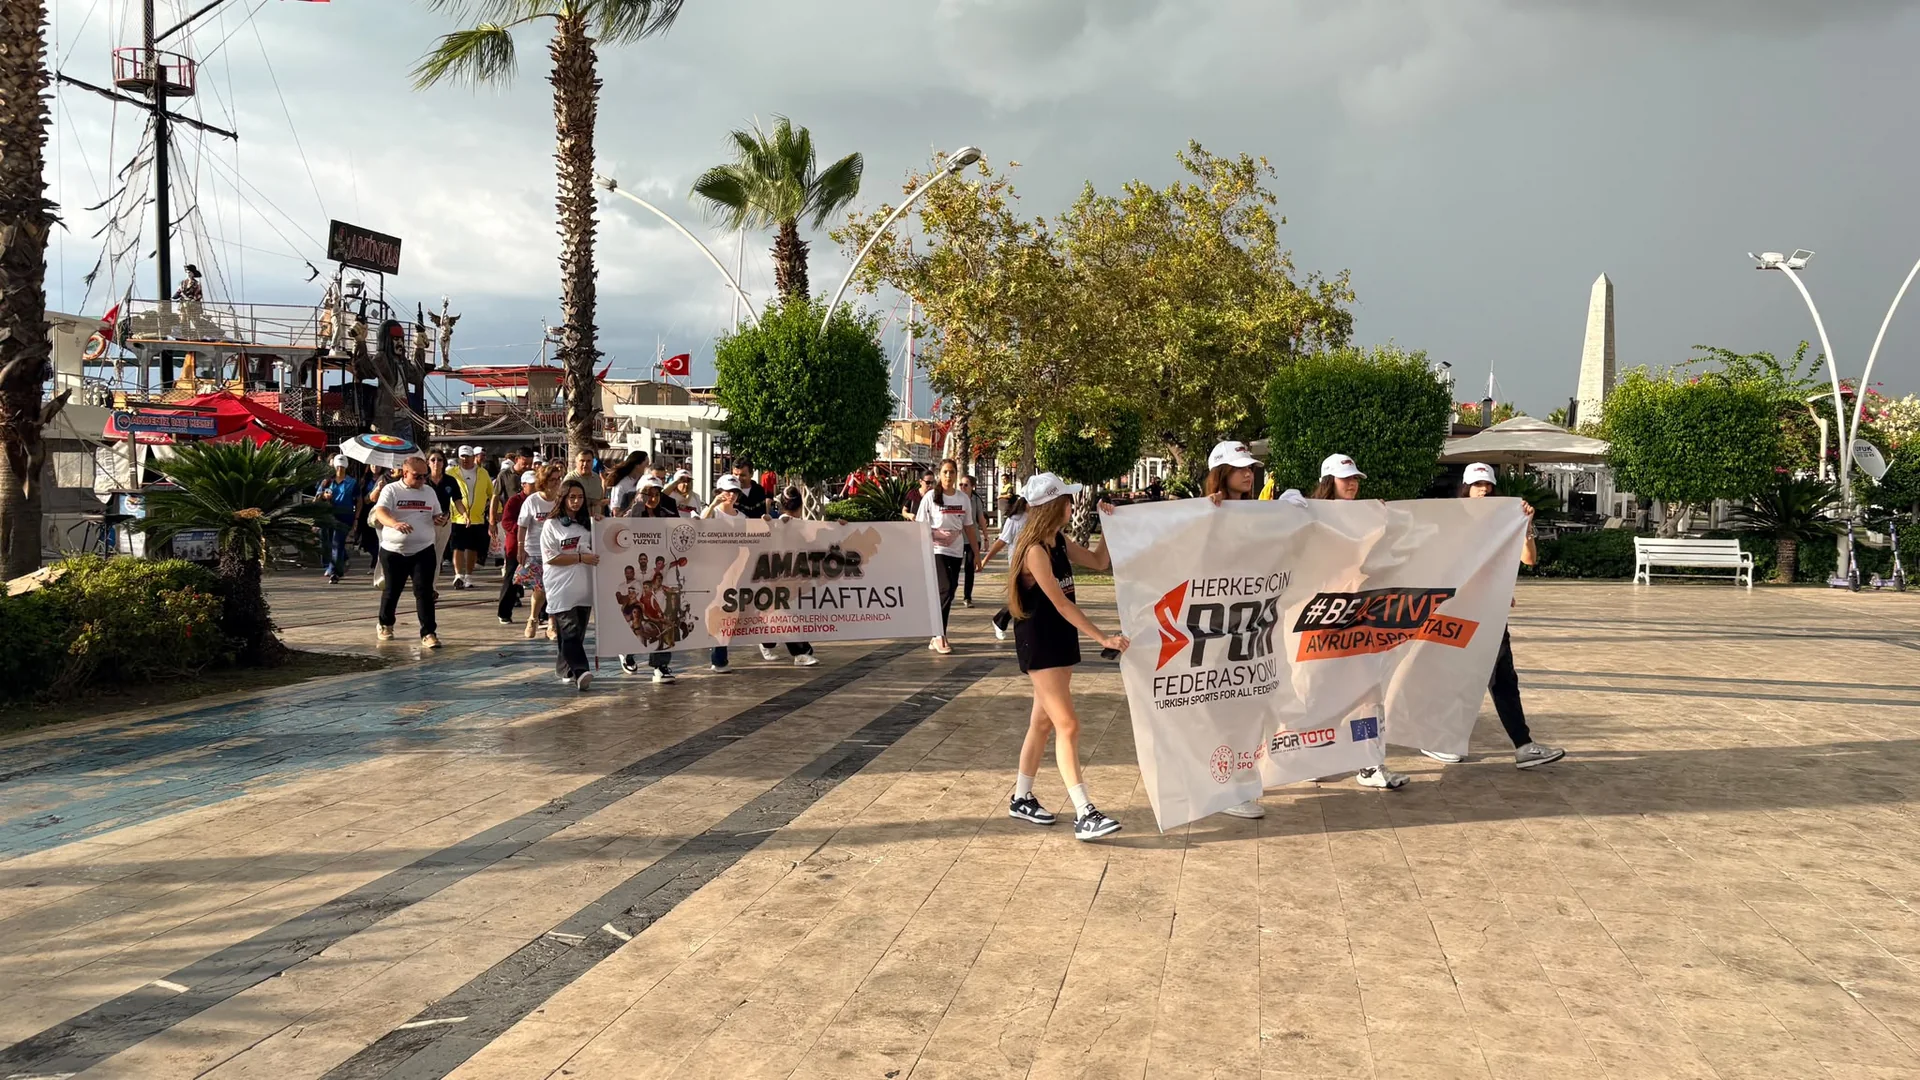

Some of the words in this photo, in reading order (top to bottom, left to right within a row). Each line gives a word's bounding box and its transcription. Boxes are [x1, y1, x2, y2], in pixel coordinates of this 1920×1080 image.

[752, 545, 863, 581] AMATÖR
[1191, 577, 1265, 598] HERKES
[722, 586, 791, 613] SPOR
[798, 586, 904, 609] HAFTASI
[721, 616, 742, 627] TÜRK
[770, 613, 828, 623] AMATÖRLERİN
[830, 612, 892, 622] OMUZLARINDA
[721, 627, 769, 636] YÜKSELMEYE
[770, 625, 801, 634] DEVAM
[802, 623, 838, 633] EDİYOR.
[1306, 630, 1375, 654] AVRUPA
[1153, 657, 1277, 698] FEDERASYONU
[1155, 697, 1190, 710] TURKISH
[1190, 692, 1219, 705] SPORTS
[1219, 689, 1236, 700] FOR
[1236, 686, 1252, 698] ALL
[1271, 734, 1300, 751] SPOR
[1299, 728, 1335, 744] TOTO
[1237, 752, 1252, 760] T.C.
